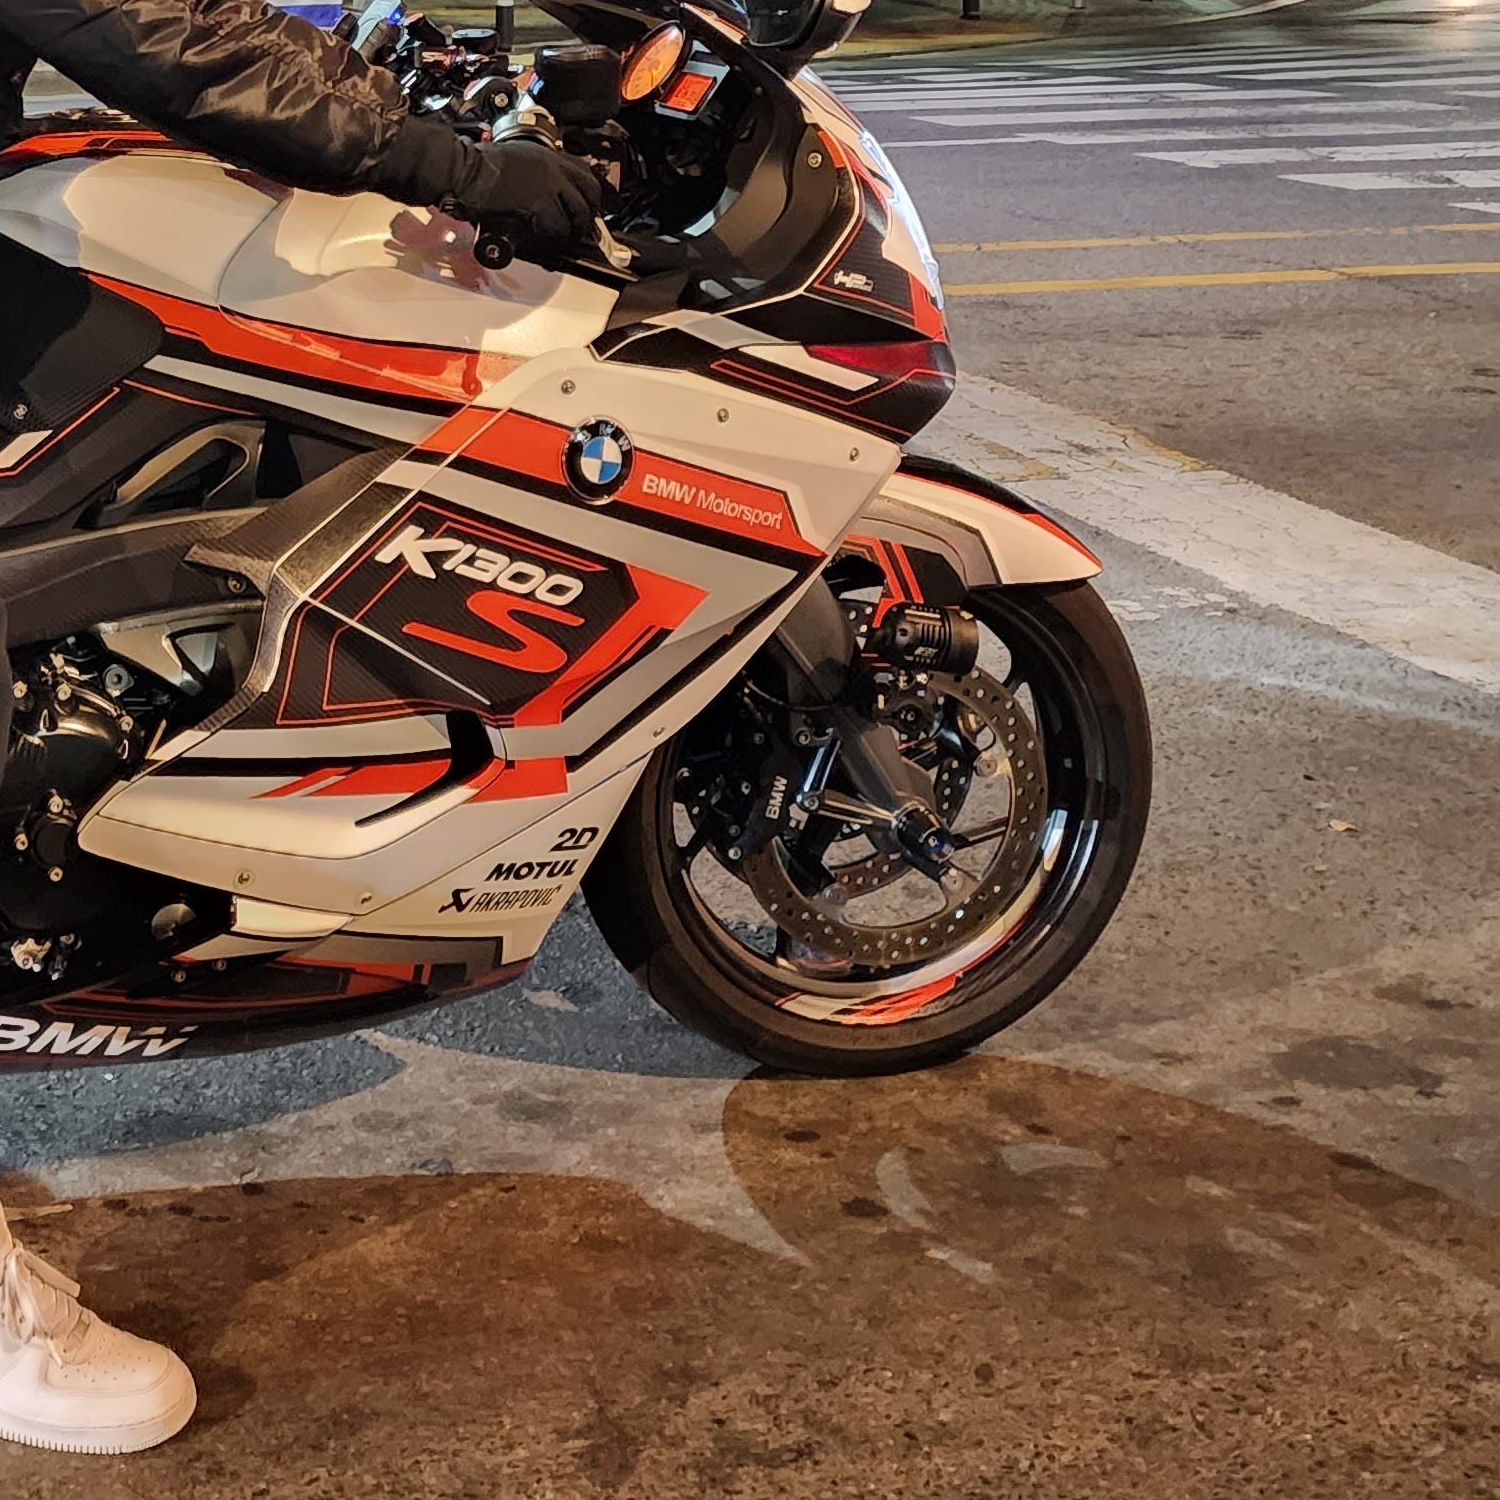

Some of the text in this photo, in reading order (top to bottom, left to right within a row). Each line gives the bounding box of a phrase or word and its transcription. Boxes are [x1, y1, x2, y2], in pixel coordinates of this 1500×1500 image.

[642, 473, 783, 531] BMW Motorsport
[374, 526, 584, 607] K1300
[401, 590, 587, 673] S
[765, 775, 788, 820] BMW
[484, 858, 580, 882] MOTUL
